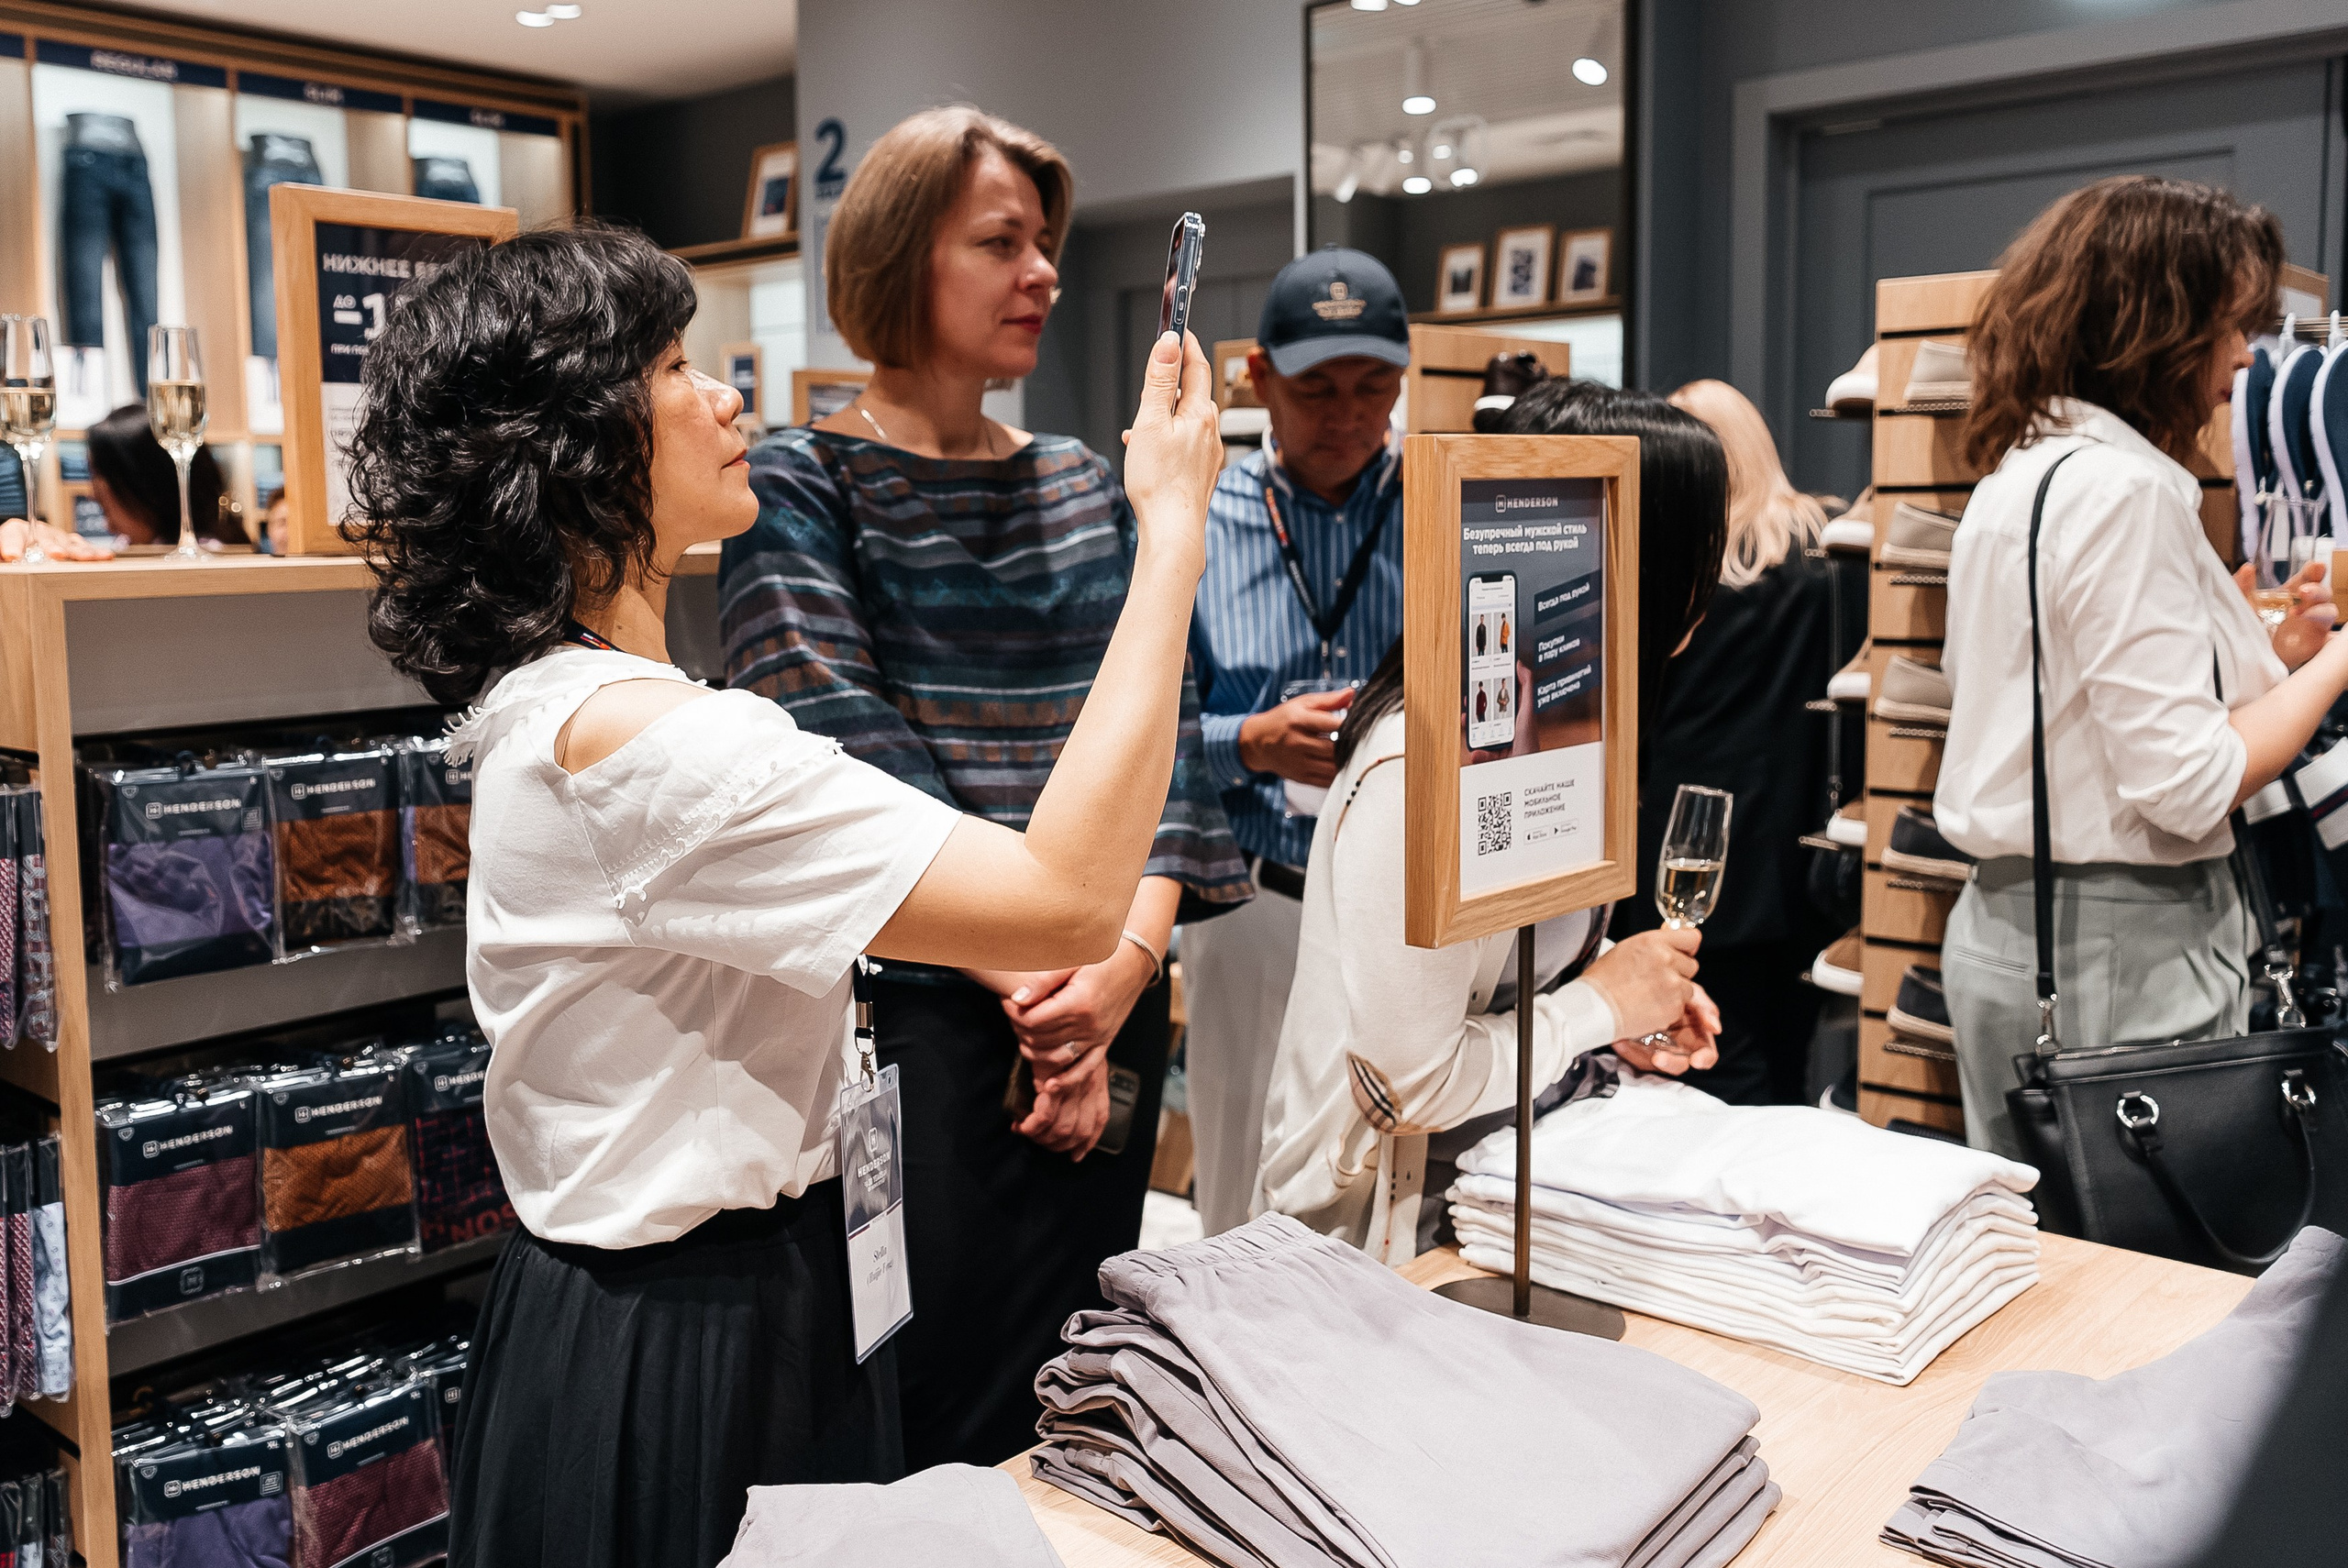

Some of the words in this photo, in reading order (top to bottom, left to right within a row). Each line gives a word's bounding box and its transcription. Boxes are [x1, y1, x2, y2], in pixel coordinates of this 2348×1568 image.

[814, 116, 847, 184] 2
[323, 253, 411, 278] НИЖНЕЕ
[333, 294, 357, 309] ДО
[1506, 496, 1558, 509] HENDERSON
[1463, 525, 1523, 542] Безупречный
[1524, 523, 1562, 539] мужской
[1563, 524, 1588, 536] стиль
[1472, 543, 1504, 556] теперь
[1505, 541, 1534, 554] всегда
[1535, 540, 1553, 552] под
[1553, 536, 1578, 552] рукой
[306, 778, 376, 795] HENDERSON
[1524, 782, 1555, 797] СКАЧАЙТЕ
[163, 798, 242, 815] HENDERSON
[1523, 792, 1561, 808] МОБИЛЬНОЕ
[1523, 802, 1566, 819] ПРИЛОЖЕНИЕ
[449, 1071, 486, 1086] HENDE
[311, 1096, 383, 1118] HENDERSON
[160, 1125, 233, 1150] HENDERSON
[858, 1151, 891, 1178] HENDERSON
[341, 1415, 409, 1452] HENDERSON
[182, 1465, 261, 1492] HENDERSON
